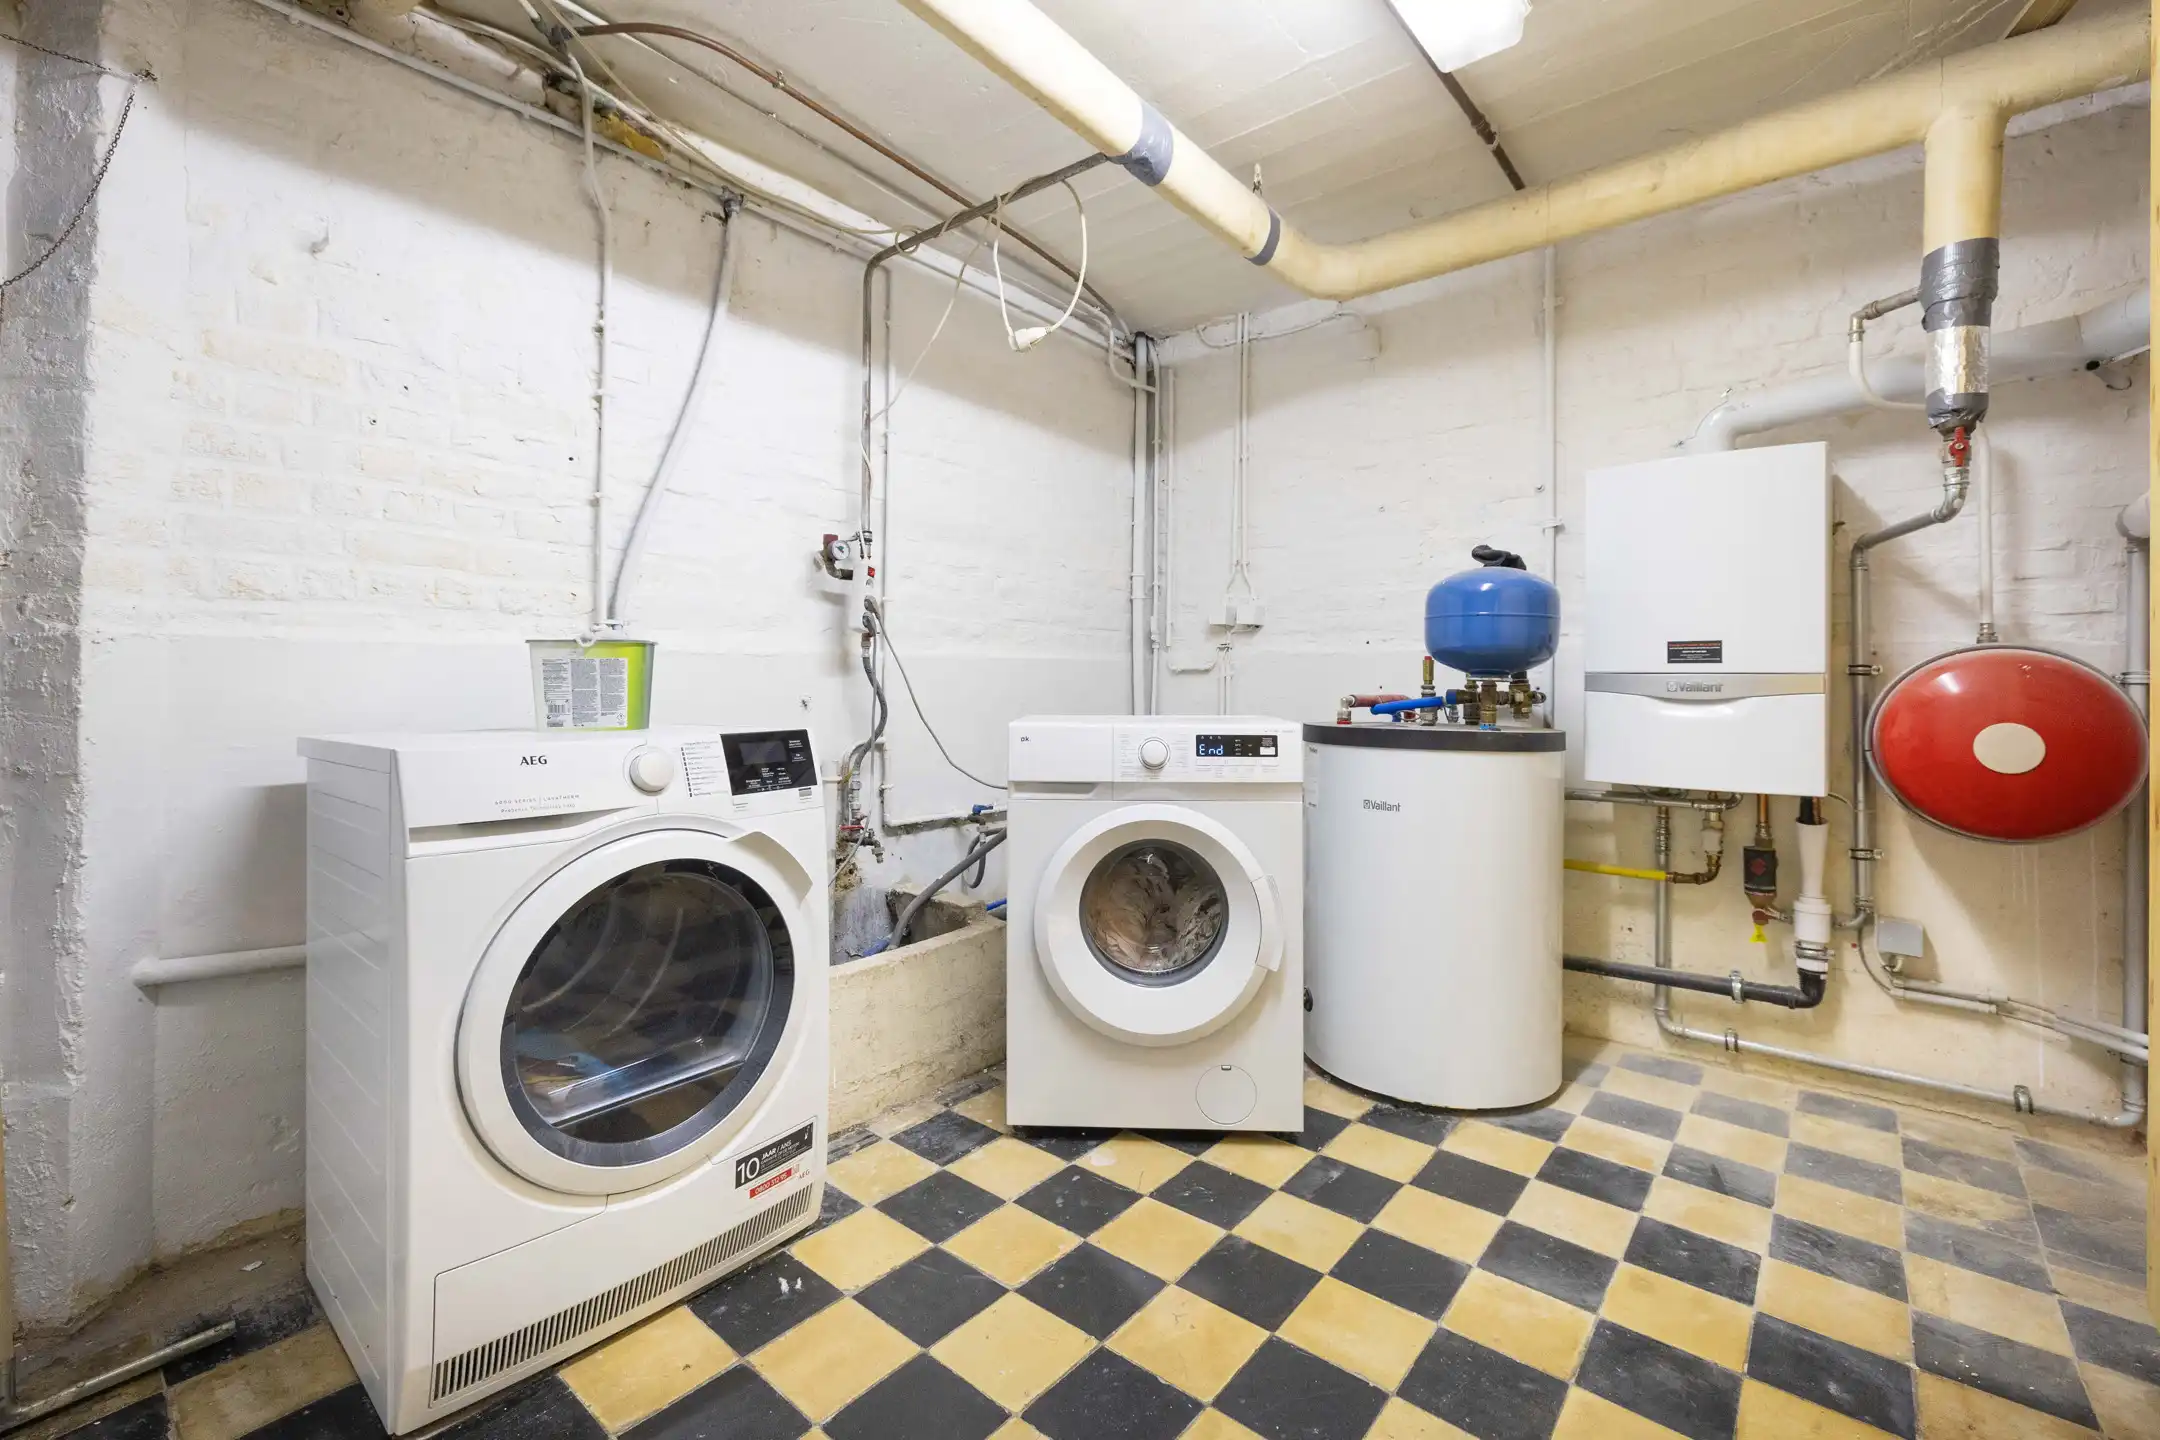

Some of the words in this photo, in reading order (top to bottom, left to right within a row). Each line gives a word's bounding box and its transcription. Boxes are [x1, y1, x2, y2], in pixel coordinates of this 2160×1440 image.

[1199, 743, 1224, 756] End
[520, 755, 548, 766] AEG
[1371, 800, 1401, 812] Vaillant
[737, 1157, 760, 1184] 10
[761, 1147, 776, 1160] JAAR
[780, 1140, 792, 1151] ANS
